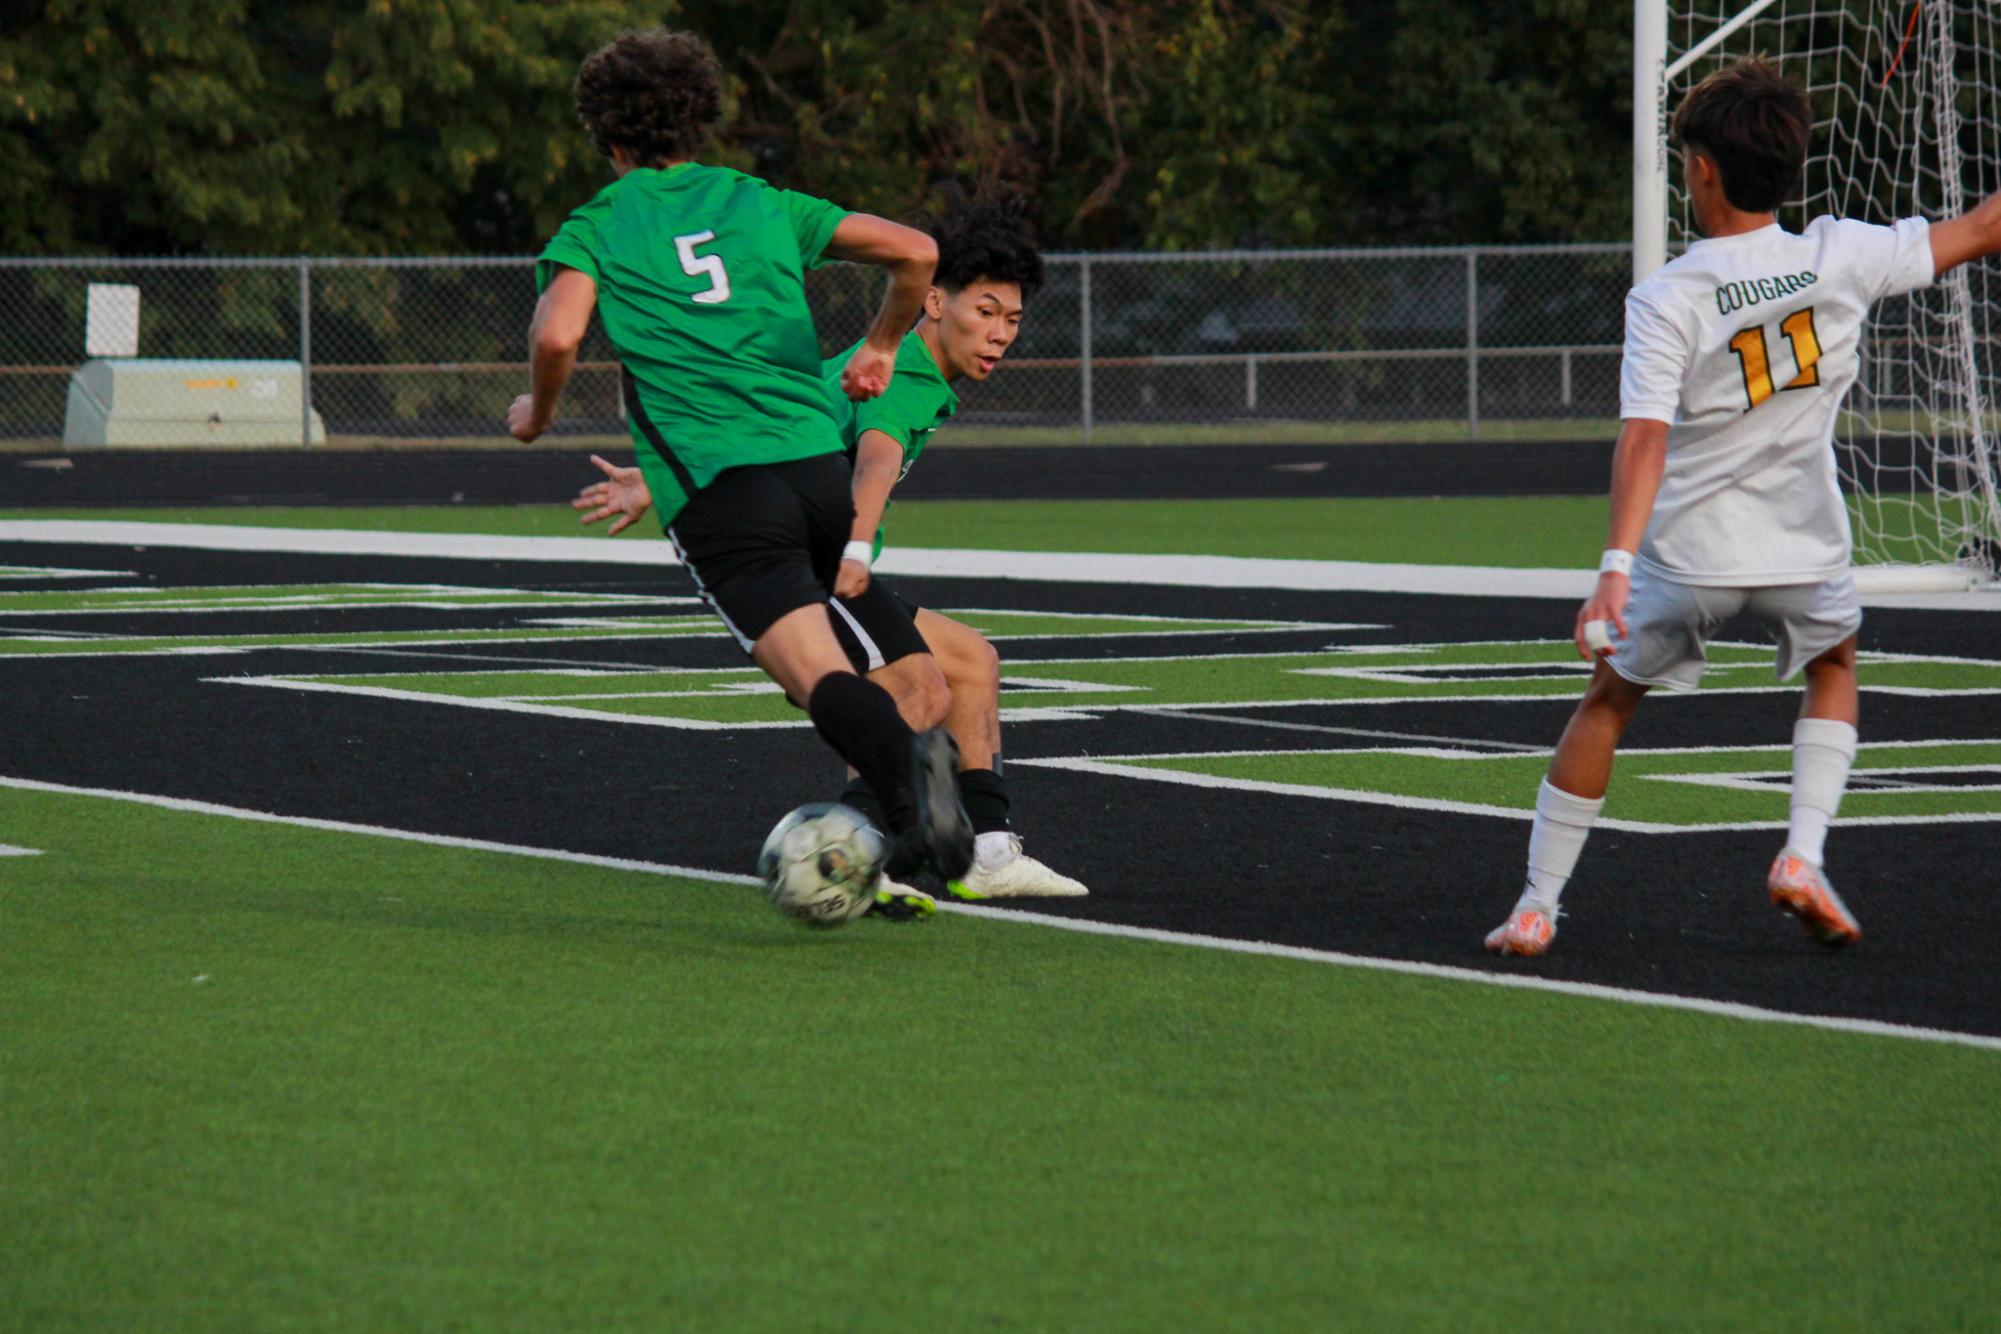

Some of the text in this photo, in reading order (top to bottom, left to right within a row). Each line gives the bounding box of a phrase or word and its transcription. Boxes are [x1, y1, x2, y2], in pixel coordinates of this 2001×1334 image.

[673, 228, 731, 303] 5
[1716, 271, 1818, 315] COUGARS
[1728, 306, 1824, 414] 11
